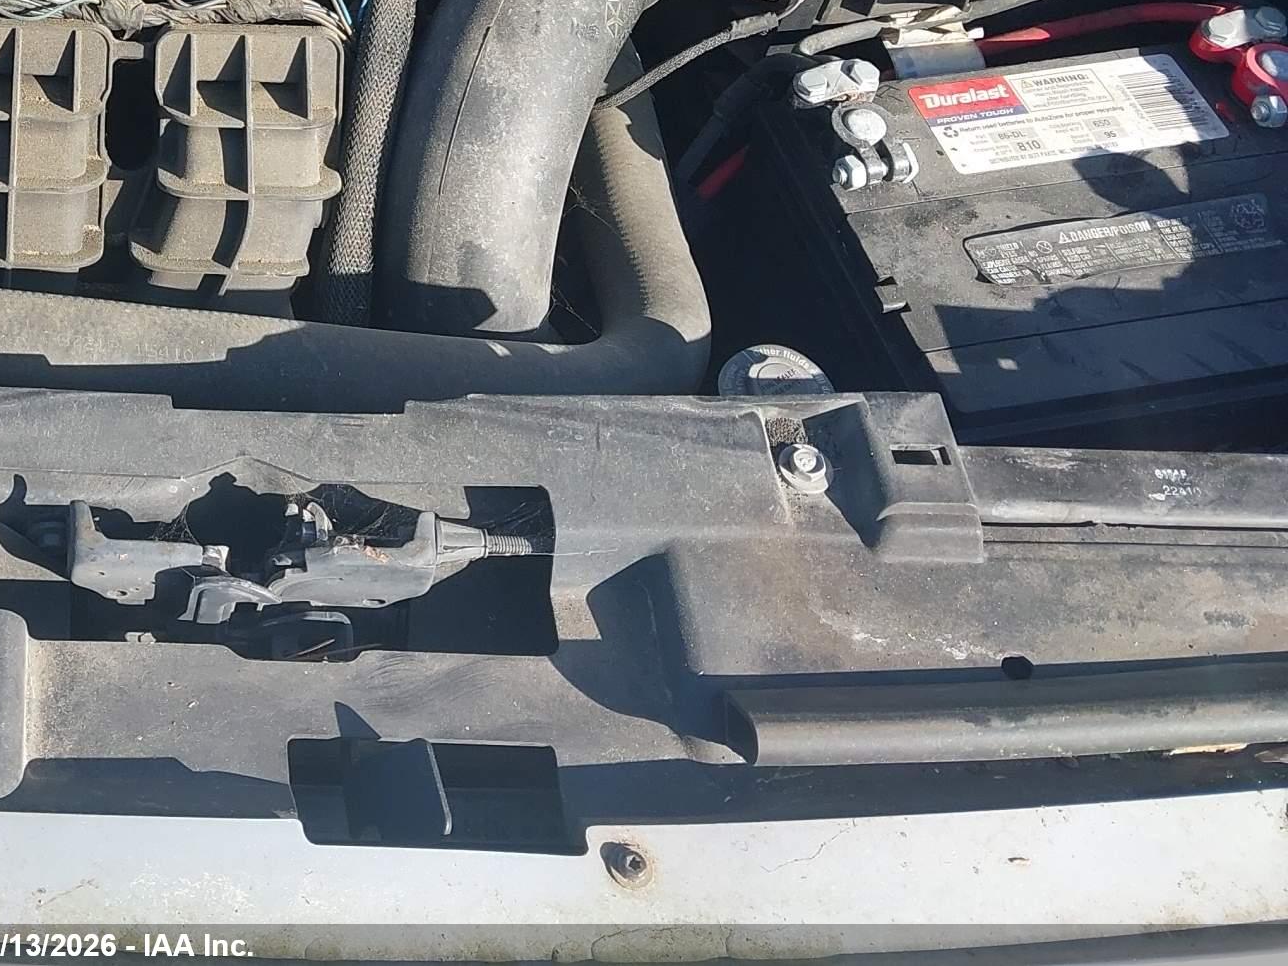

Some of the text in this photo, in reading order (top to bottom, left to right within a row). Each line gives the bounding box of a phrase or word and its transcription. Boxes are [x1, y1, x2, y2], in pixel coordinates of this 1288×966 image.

[1031, 73, 1090, 87] WARNING:
[919, 84, 1010, 109] Duralast
[937, 107, 1015, 125] PROVEN TOUGH
[1103, 130, 1117, 139] 95
[1016, 139, 1041, 151] 810
[1070, 220, 1152, 243] DANGER/POISON
